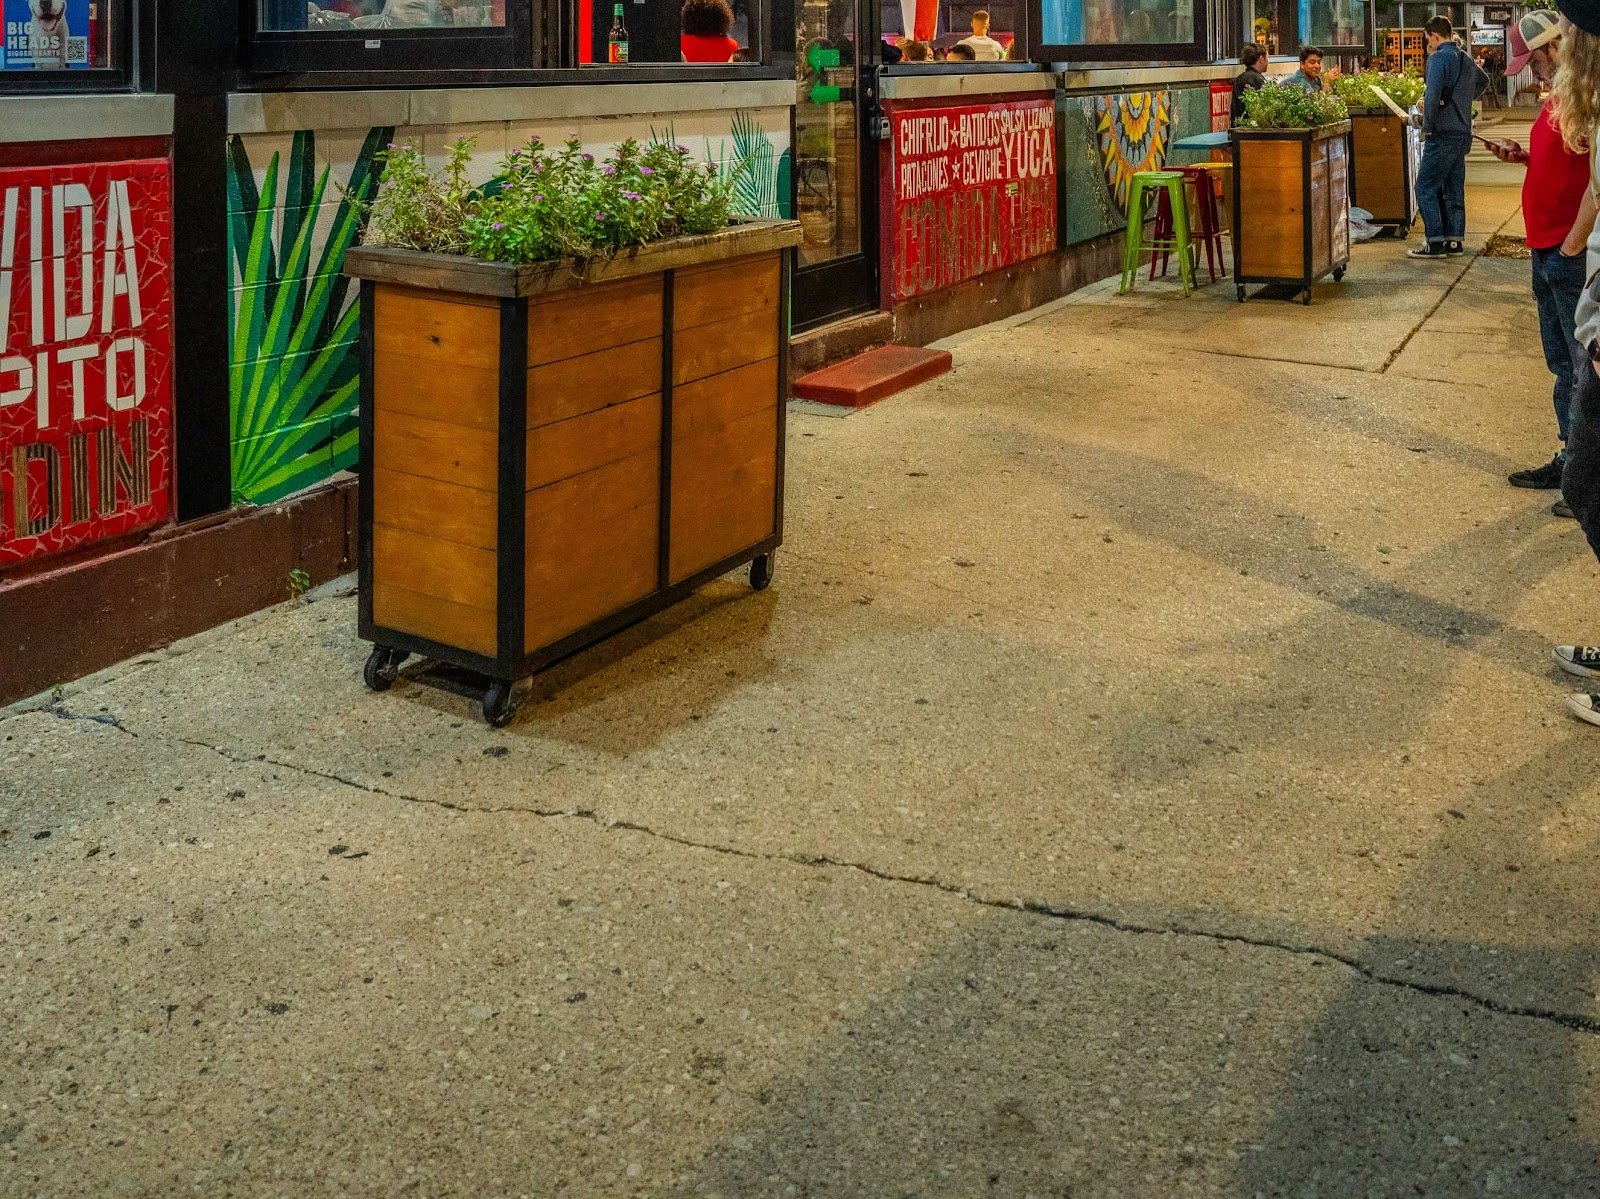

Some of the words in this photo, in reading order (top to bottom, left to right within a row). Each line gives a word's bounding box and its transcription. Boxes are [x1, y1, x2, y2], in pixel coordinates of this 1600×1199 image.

[7, 21, 34, 36] BIG
[7, 36, 61, 50] HEADS
[901, 115, 949, 157] CHIFRIJO
[960, 110, 1000, 149] BATIDOS
[1000, 108, 1026, 135] SALSA
[1027, 107, 1054, 131] LIZANO
[901, 155, 949, 200] PATACONES
[962, 147, 1003, 186] CEVICHE
[1001, 128, 1054, 179] YUCA
[12, 418, 150, 539] DIN
